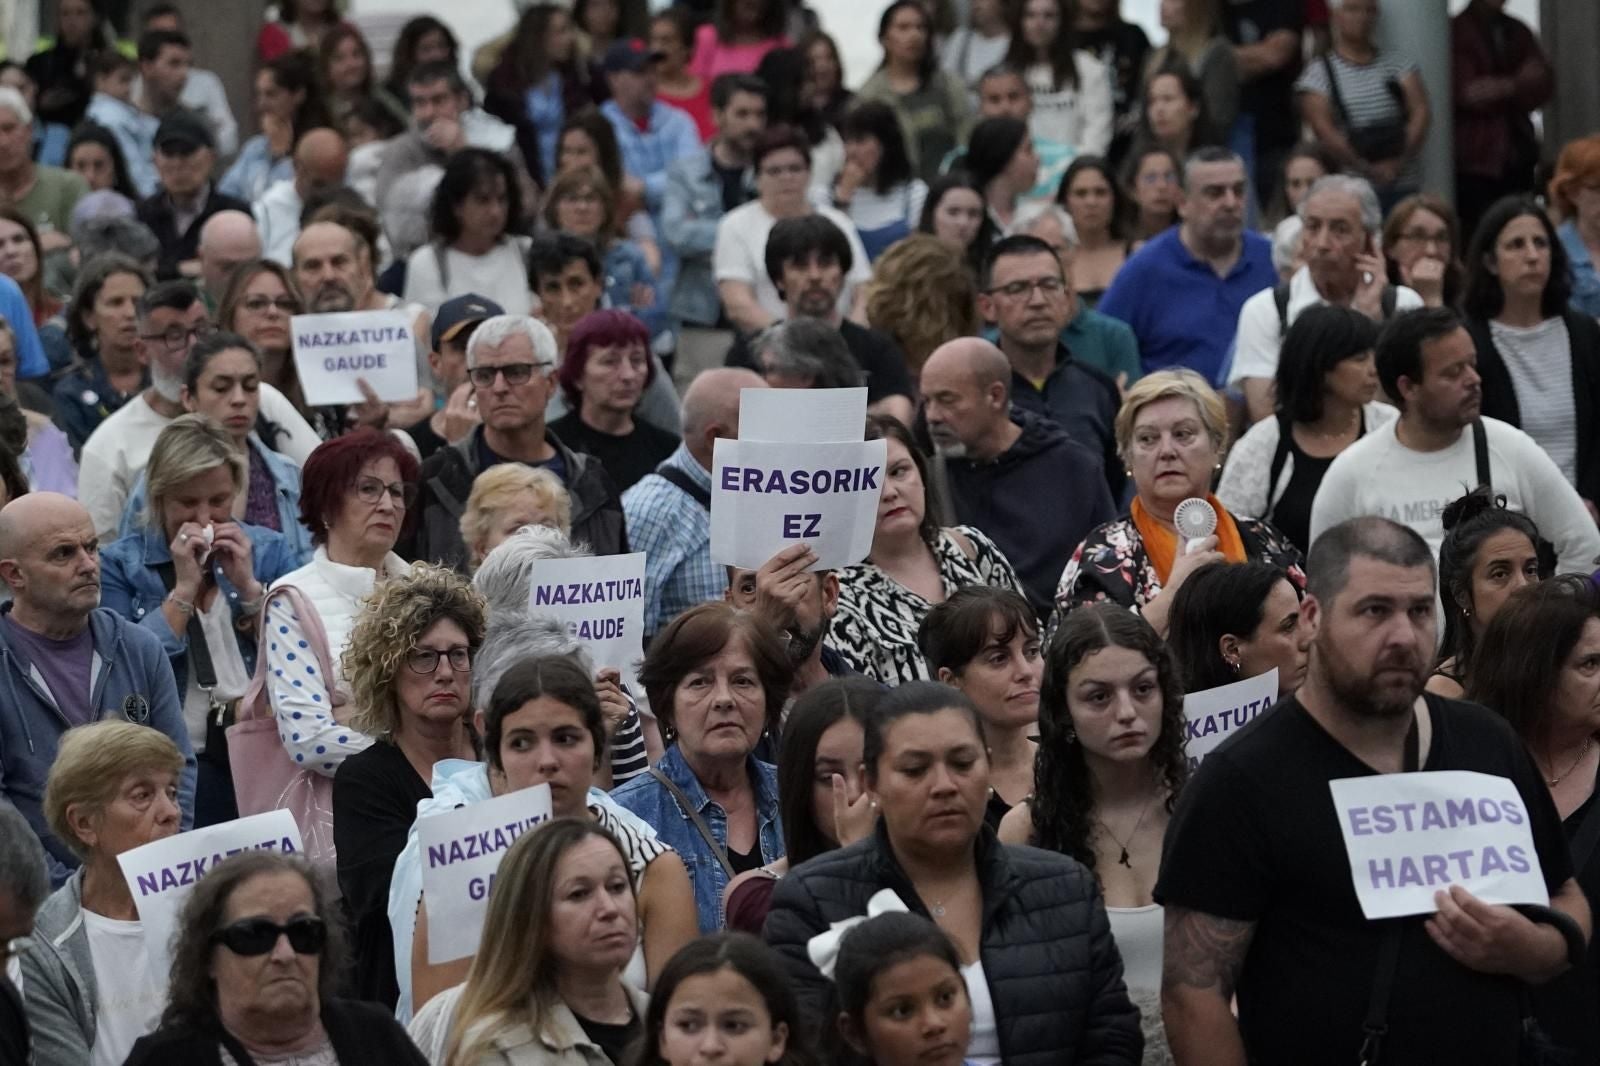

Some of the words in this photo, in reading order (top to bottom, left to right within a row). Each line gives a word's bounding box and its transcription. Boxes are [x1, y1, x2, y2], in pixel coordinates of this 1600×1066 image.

[299, 327, 409, 348] NAZKATUTA
[324, 354, 387, 372] GAUDE
[721, 466, 880, 495] ERASORIK
[783, 514, 822, 538] EZ
[536, 578, 642, 606] NAZKATUTA
[1347, 798, 1523, 836] ESTAMOS
[1368, 845, 1531, 889] HARTAS
